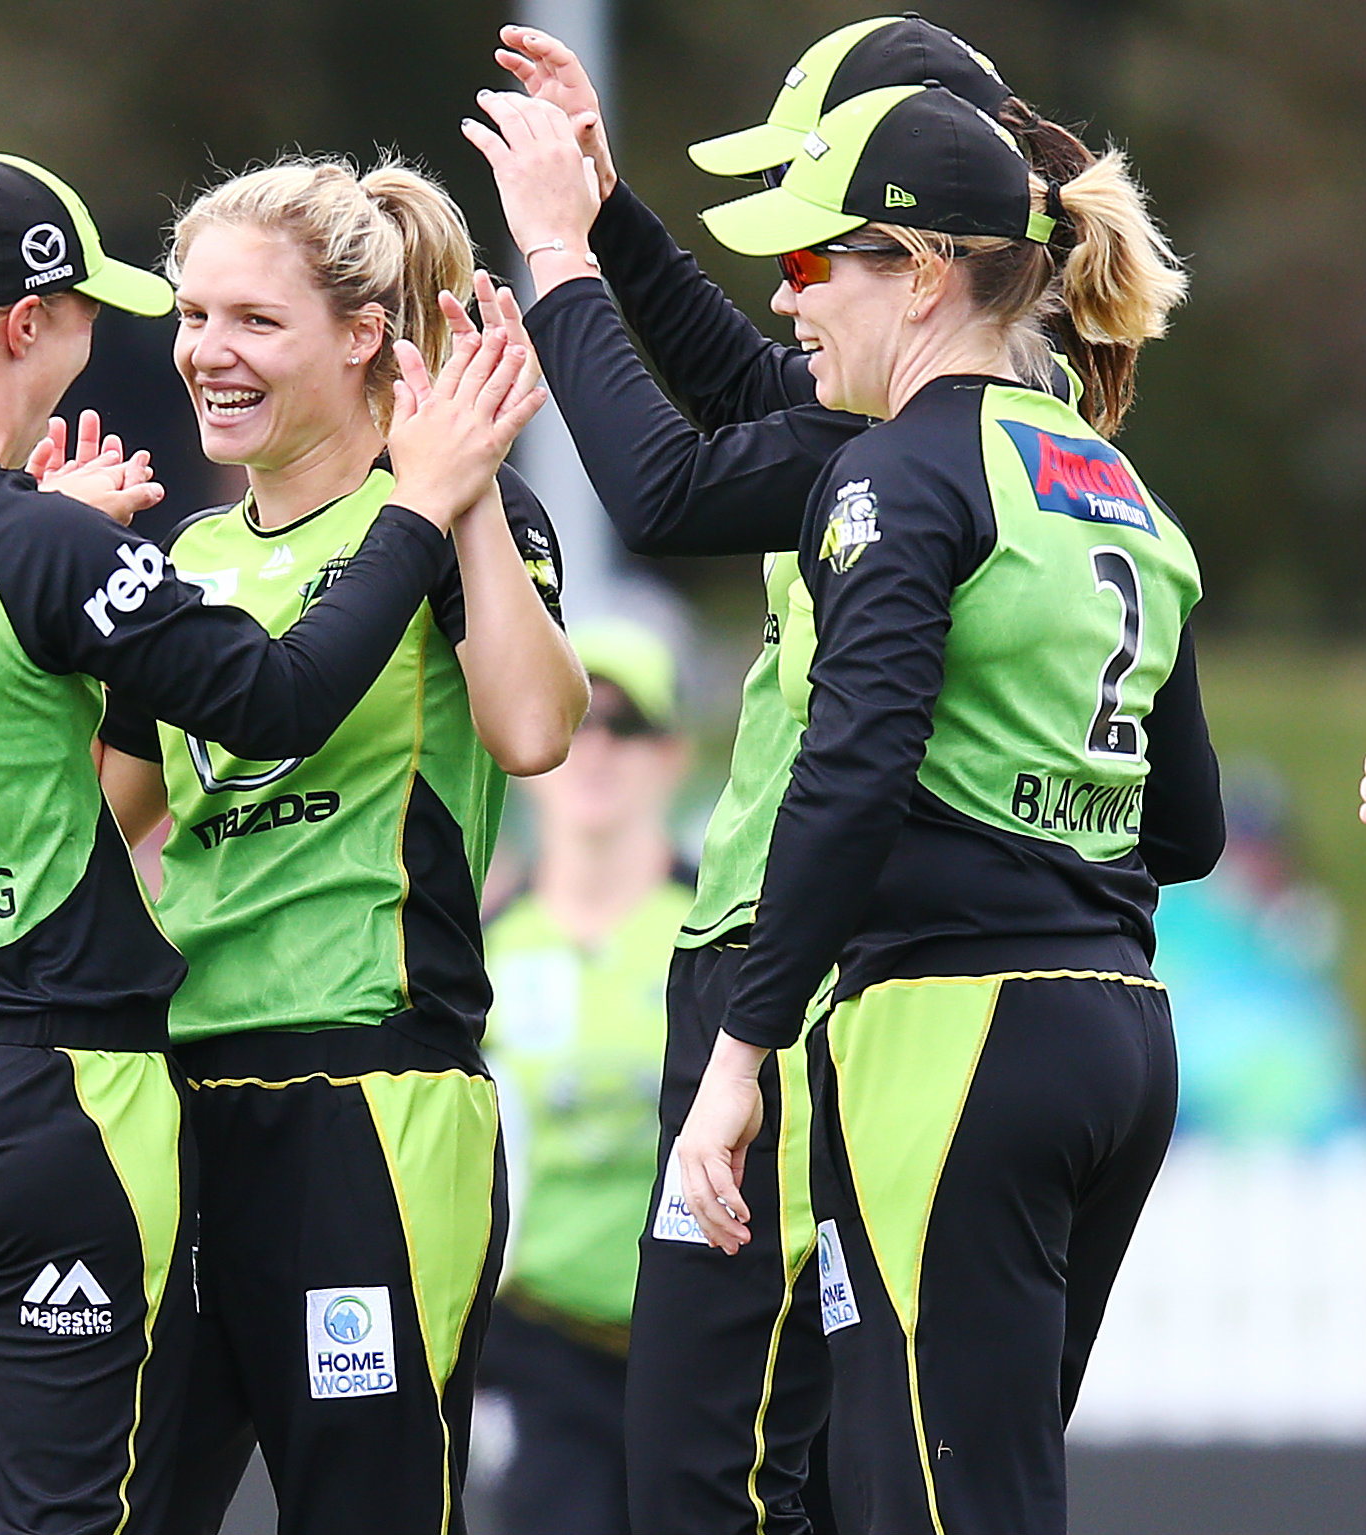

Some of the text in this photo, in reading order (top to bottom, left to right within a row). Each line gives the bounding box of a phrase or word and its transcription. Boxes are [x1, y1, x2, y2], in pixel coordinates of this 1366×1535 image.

[82, 542, 173, 638] reb
[1085, 545, 1144, 763] 2
[1011, 772, 1142, 835] BLACKWE
[659, 1215, 705, 1239] WOR
[822, 1282, 847, 1307] OME
[20, 1304, 113, 1334] Majestic
[317, 1351, 386, 1373] HOME
[313, 1373, 394, 1396] WORLD
